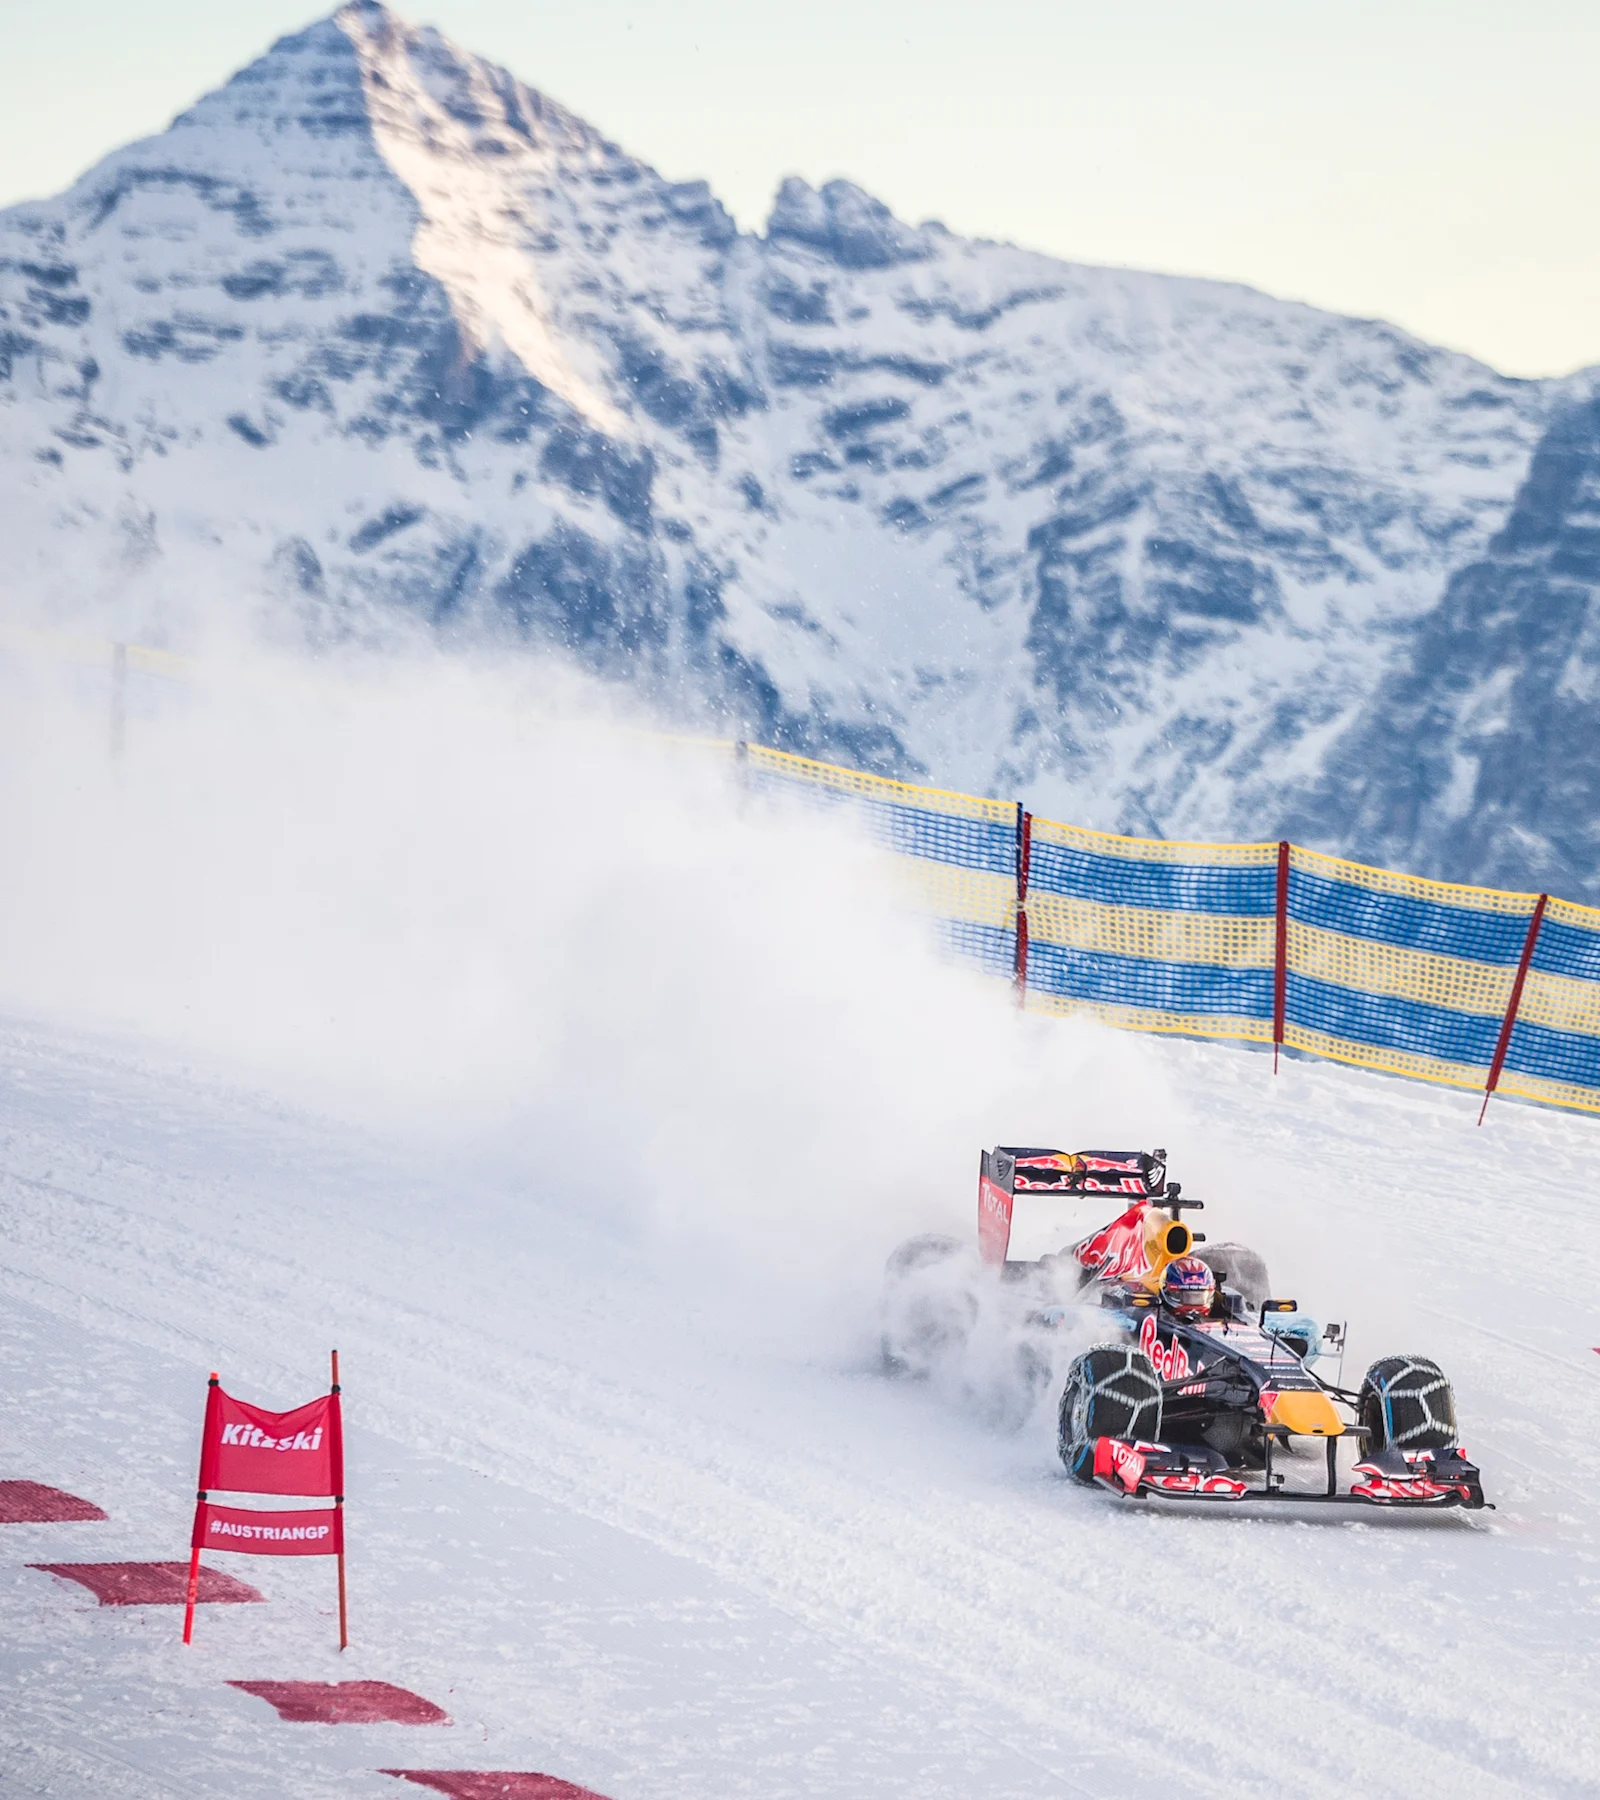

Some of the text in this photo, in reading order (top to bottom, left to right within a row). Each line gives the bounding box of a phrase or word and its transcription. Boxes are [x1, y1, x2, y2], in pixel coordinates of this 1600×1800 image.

[982, 1182, 1009, 1224] TOTAL
[1108, 1439, 1142, 1477] TOTAL
[210, 1520, 329, 1541] #AUSTRIANGP
